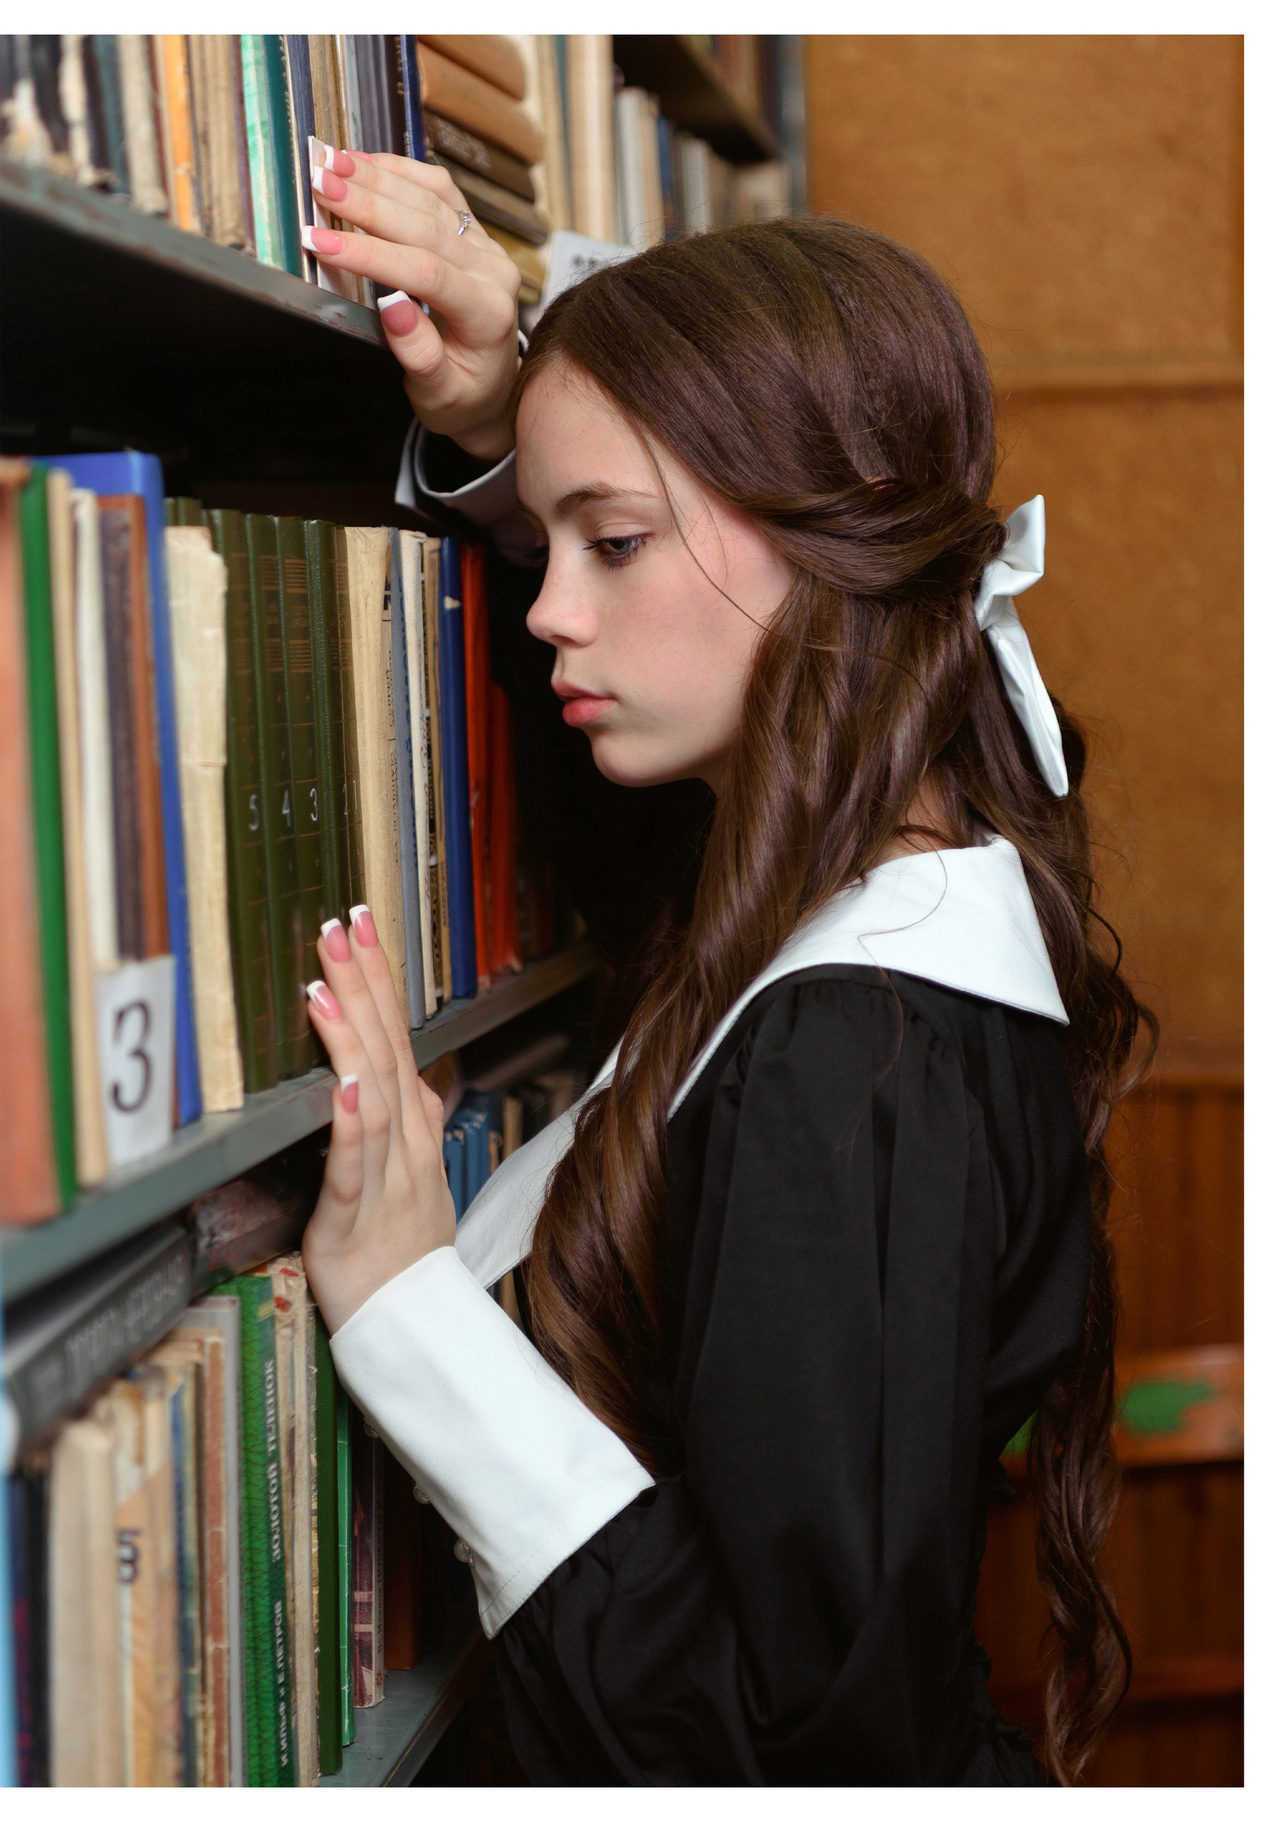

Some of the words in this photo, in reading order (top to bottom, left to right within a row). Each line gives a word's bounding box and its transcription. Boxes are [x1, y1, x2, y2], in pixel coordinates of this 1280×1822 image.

[248, 793, 260, 831] 5
[281, 788, 291, 827] 4
[309, 787, 319, 822] 3
[111, 1000, 153, 1113] 3
[264, 1358, 278, 1458] ТЕЛЕНОК
[266, 1462, 282, 1562] ЗОЛОТОЙ
[275, 1599, 286, 1685] Е.ПЕТРОВ
